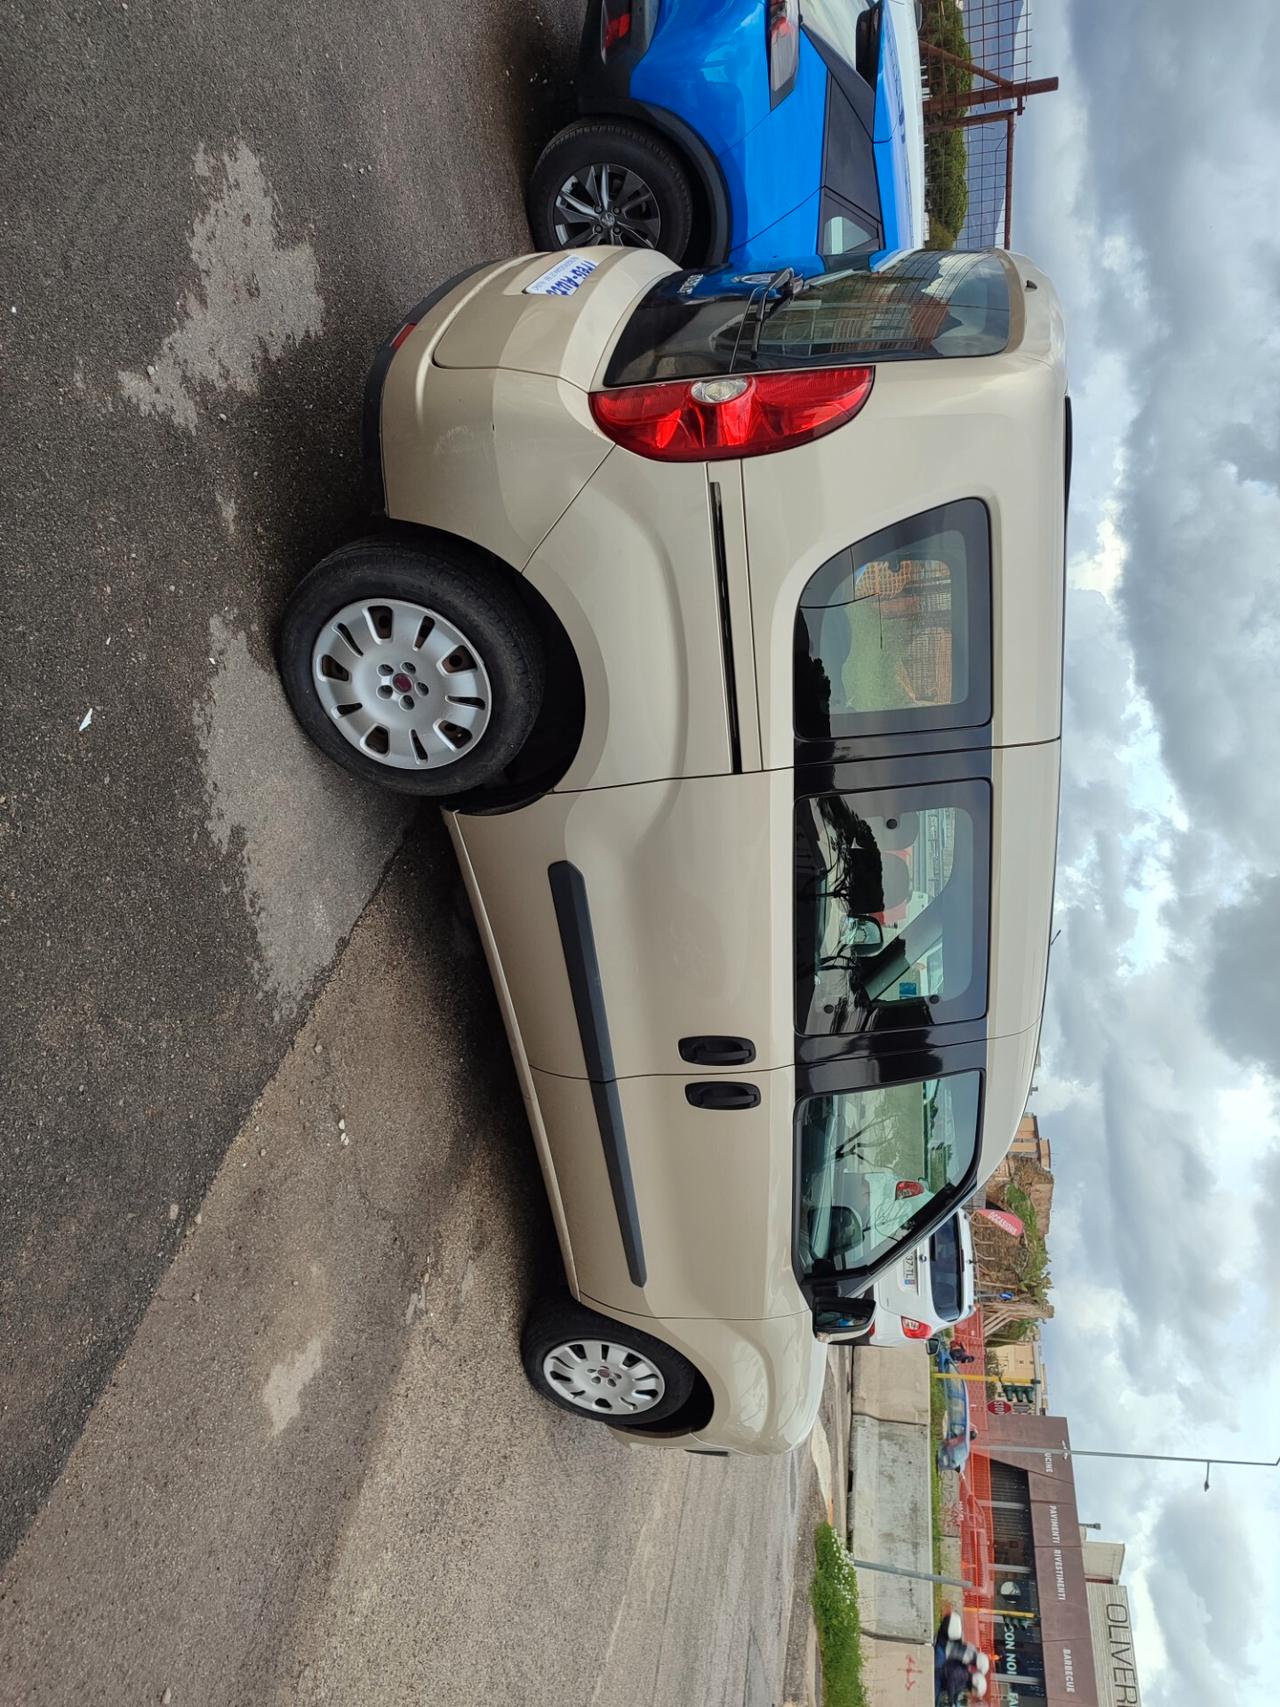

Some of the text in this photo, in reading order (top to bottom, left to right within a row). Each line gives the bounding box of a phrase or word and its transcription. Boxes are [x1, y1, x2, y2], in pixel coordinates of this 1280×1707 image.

[994, 1401, 1005, 1415] STOP
[1044, 1452, 1054, 1473] UCINE
[1049, 1505, 1067, 1601] PAVIMENTI RIVESTIMENTI
[1004, 1626, 1018, 1675] CON NOI
[1062, 1648, 1076, 1693] BARBECUE
